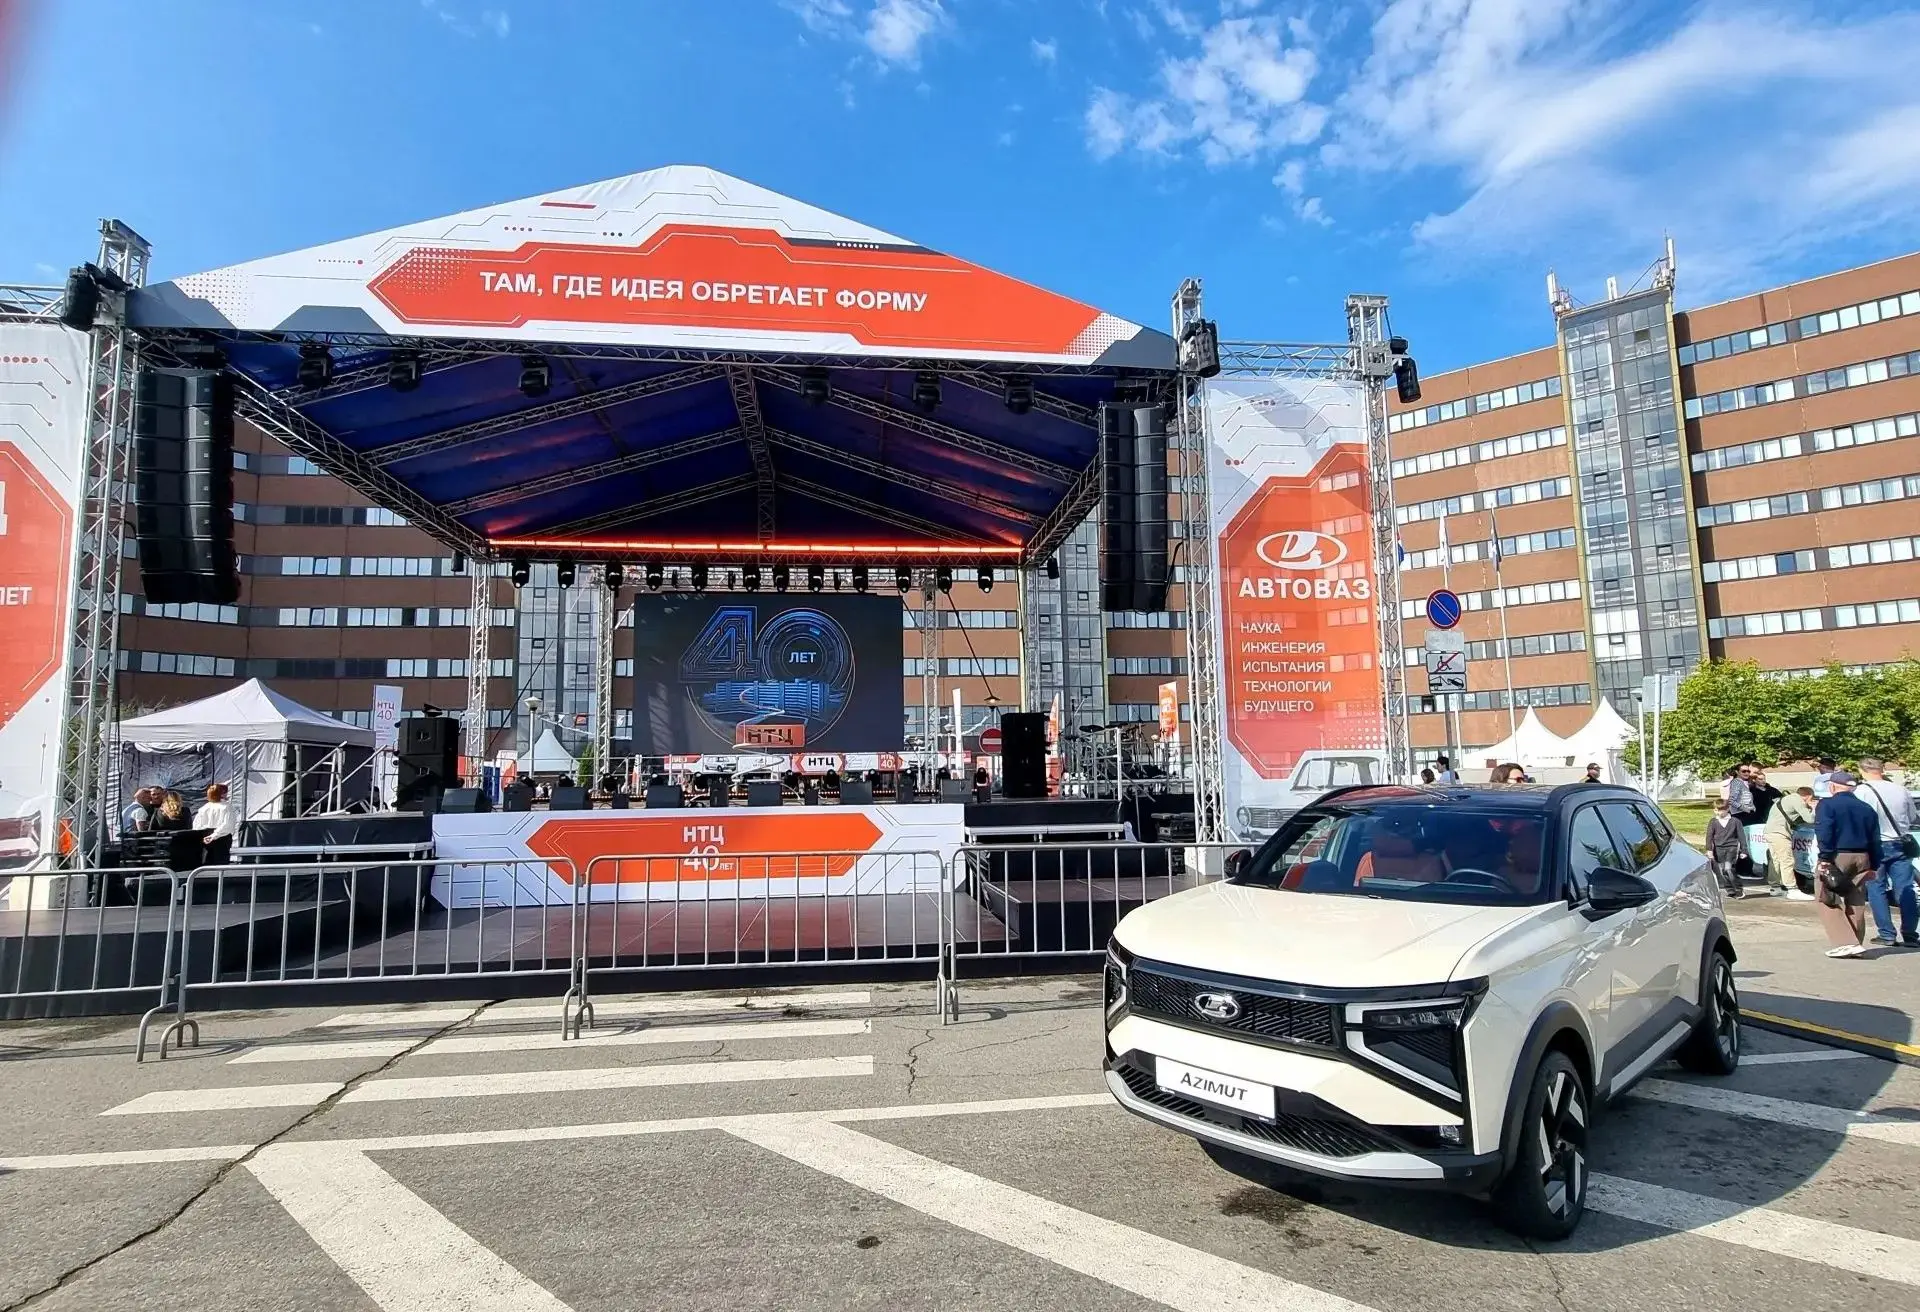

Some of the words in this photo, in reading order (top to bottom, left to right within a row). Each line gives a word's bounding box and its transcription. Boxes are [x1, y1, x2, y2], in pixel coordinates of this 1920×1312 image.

[479, 271, 543, 296] ТАМ,
[552, 274, 603, 299] ГДЕ
[611, 277, 684, 302] ИДЕЯ
[691, 281, 828, 307] ОБРЕТАЕТ
[836, 288, 928, 312] ФОРМУ
[1238, 577, 1371, 600] АВТОВАЗ
[1240, 622, 1282, 634] НАУКА
[1241, 642, 1325, 654] ИНЖЕНЕРИЯ
[788, 651, 816, 664] ЛЕТ
[1242, 661, 1325, 673] ИСПЫТАНИЯ
[1243, 680, 1332, 693] ТЕХНОЛОГИИ
[377, 702, 395, 710] НТЦ
[1244, 700, 1314, 714] БУДУЩЕГО
[377, 709, 392, 720] 40
[747, 728, 794, 745] НТЦ
[808, 757, 834, 768] НТЦ
[881, 759, 893, 769] 40
[683, 825, 725, 845] НТЦ
[683, 844, 720, 872] 40
[1180, 1071, 1248, 1101] AZIMUT
